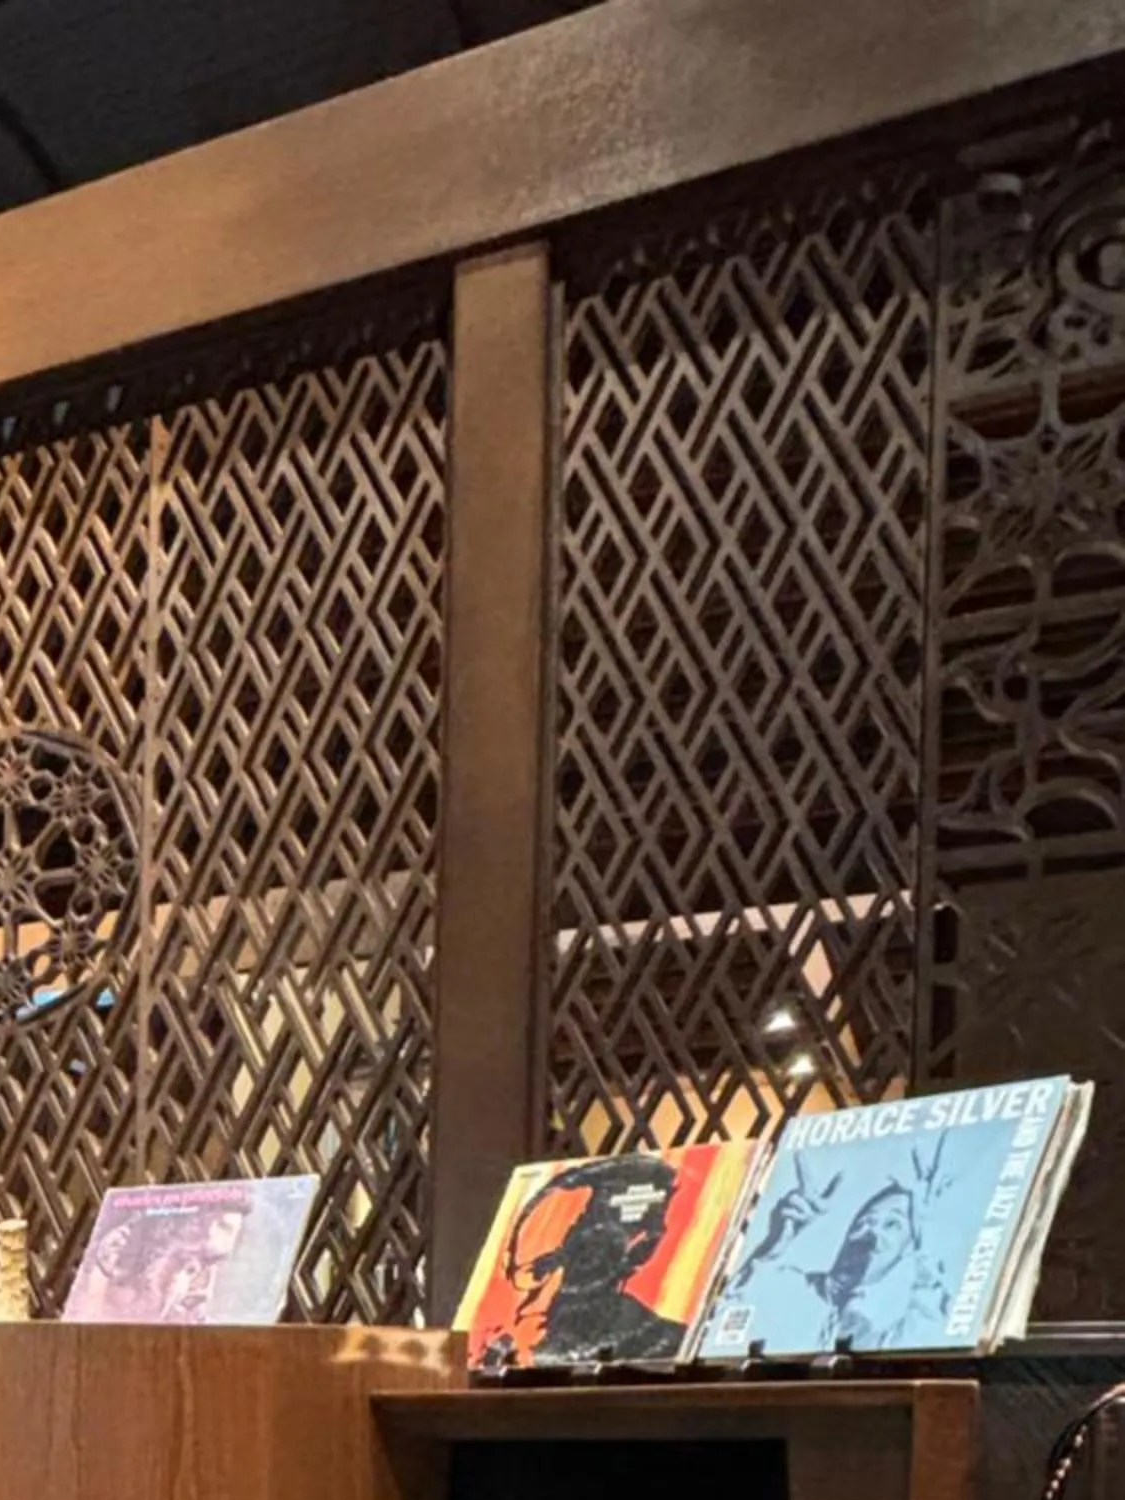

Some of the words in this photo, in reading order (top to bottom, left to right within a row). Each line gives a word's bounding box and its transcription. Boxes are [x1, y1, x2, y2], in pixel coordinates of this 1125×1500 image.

[788, 1104, 919, 1147] HORACE
[925, 1084, 1054, 1129] SILVER
[984, 1184, 1021, 1220] JAZZ
[944, 1224, 1006, 1337] MESSENGERS
